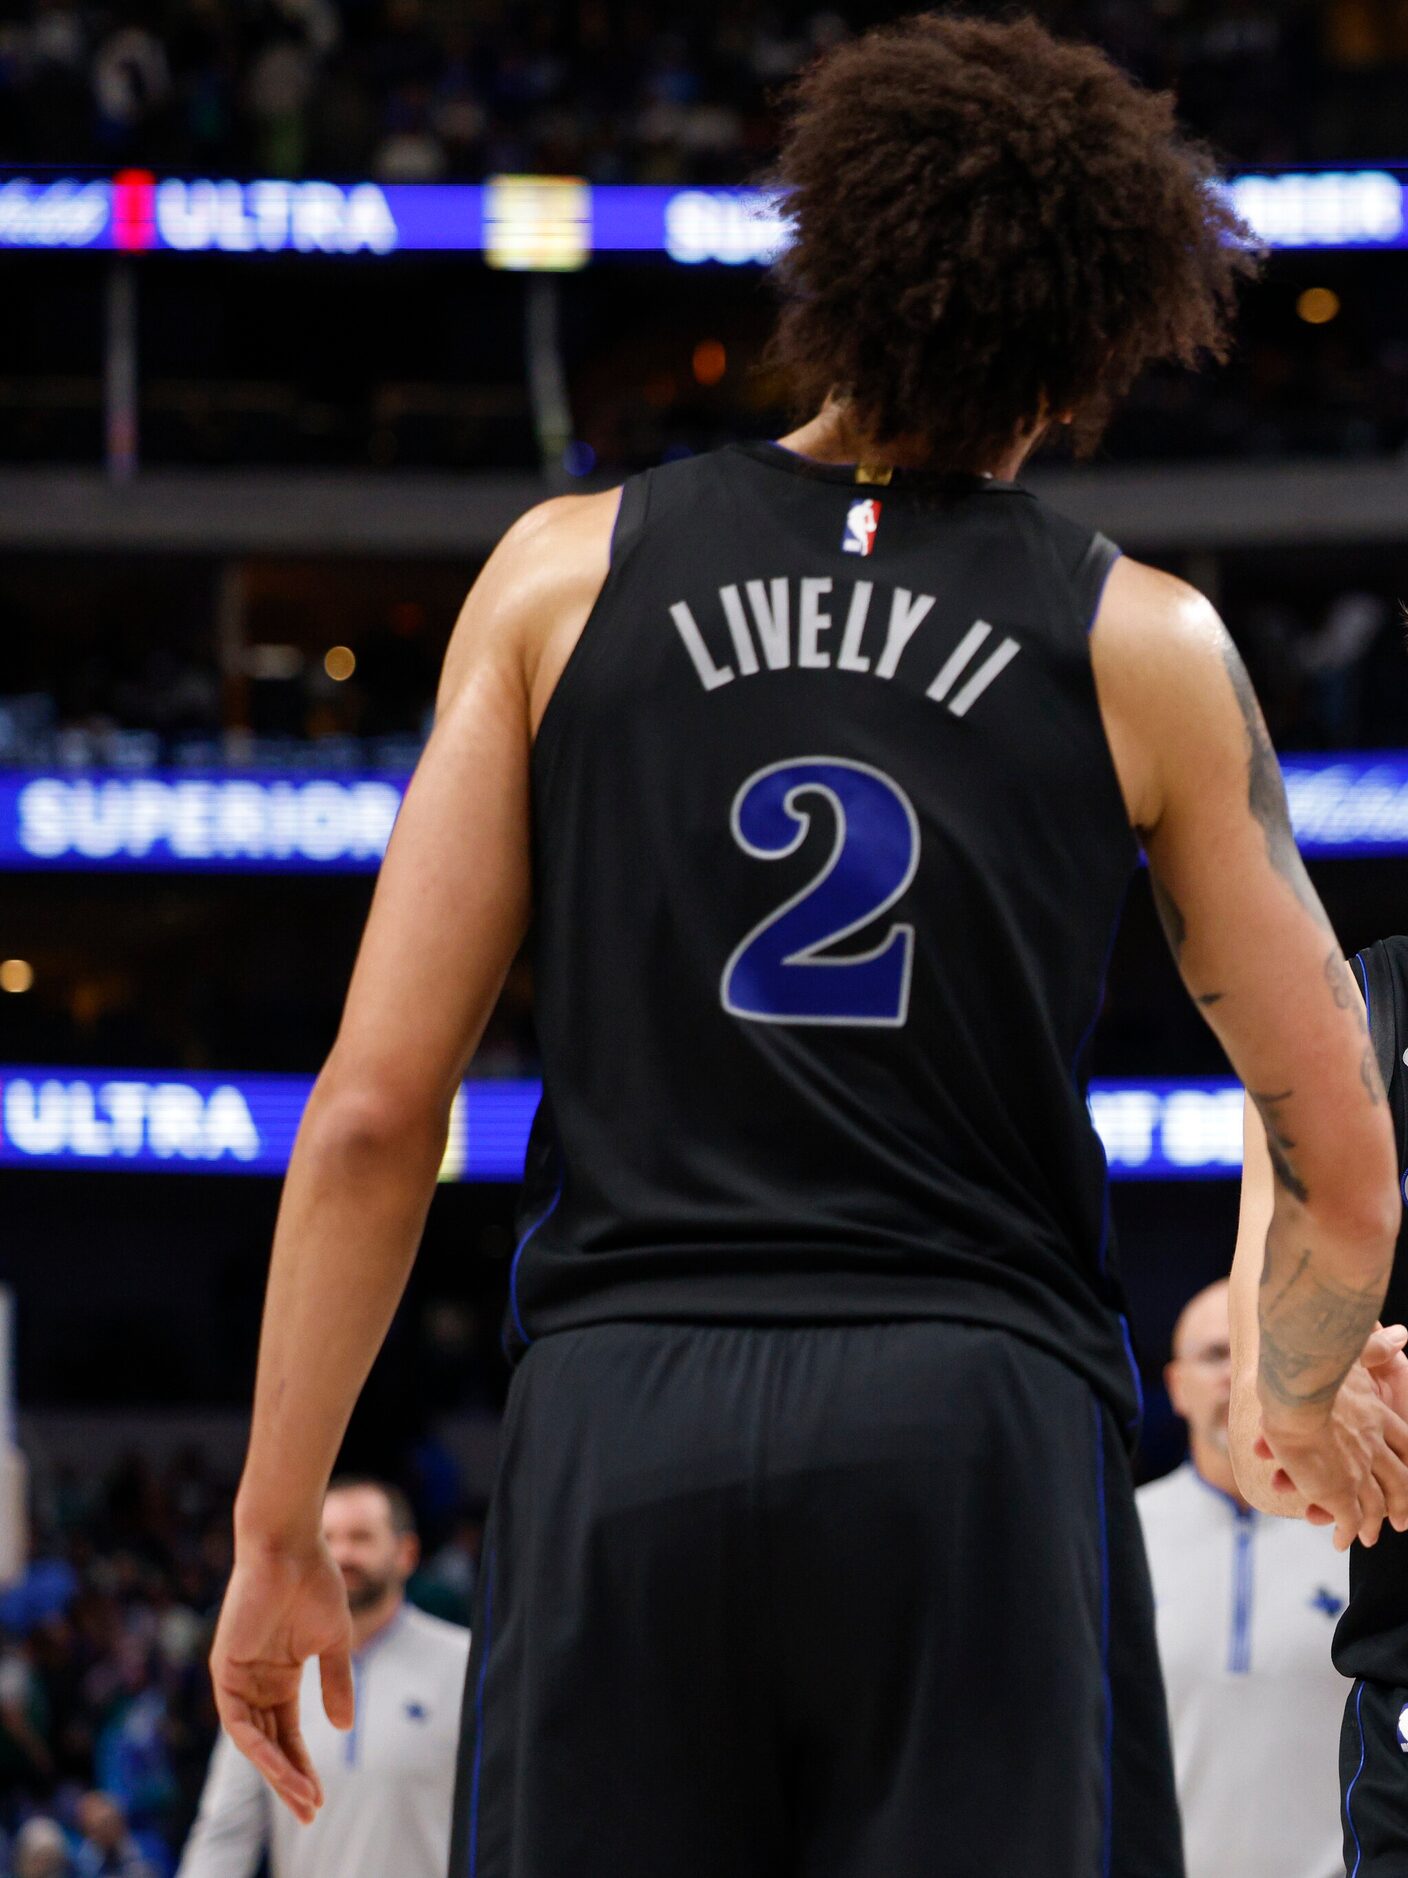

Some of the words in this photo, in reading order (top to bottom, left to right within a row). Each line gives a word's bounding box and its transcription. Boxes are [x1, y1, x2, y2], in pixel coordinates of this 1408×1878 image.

[157, 177, 398, 256] ULTRA
[669, 577, 936, 691] LIVELY
[925, 619, 1021, 718] II
[20, 777, 402, 861] SUPERIOR
[720, 755, 920, 1027] 2
[4, 1079, 260, 1162] ULTRA
